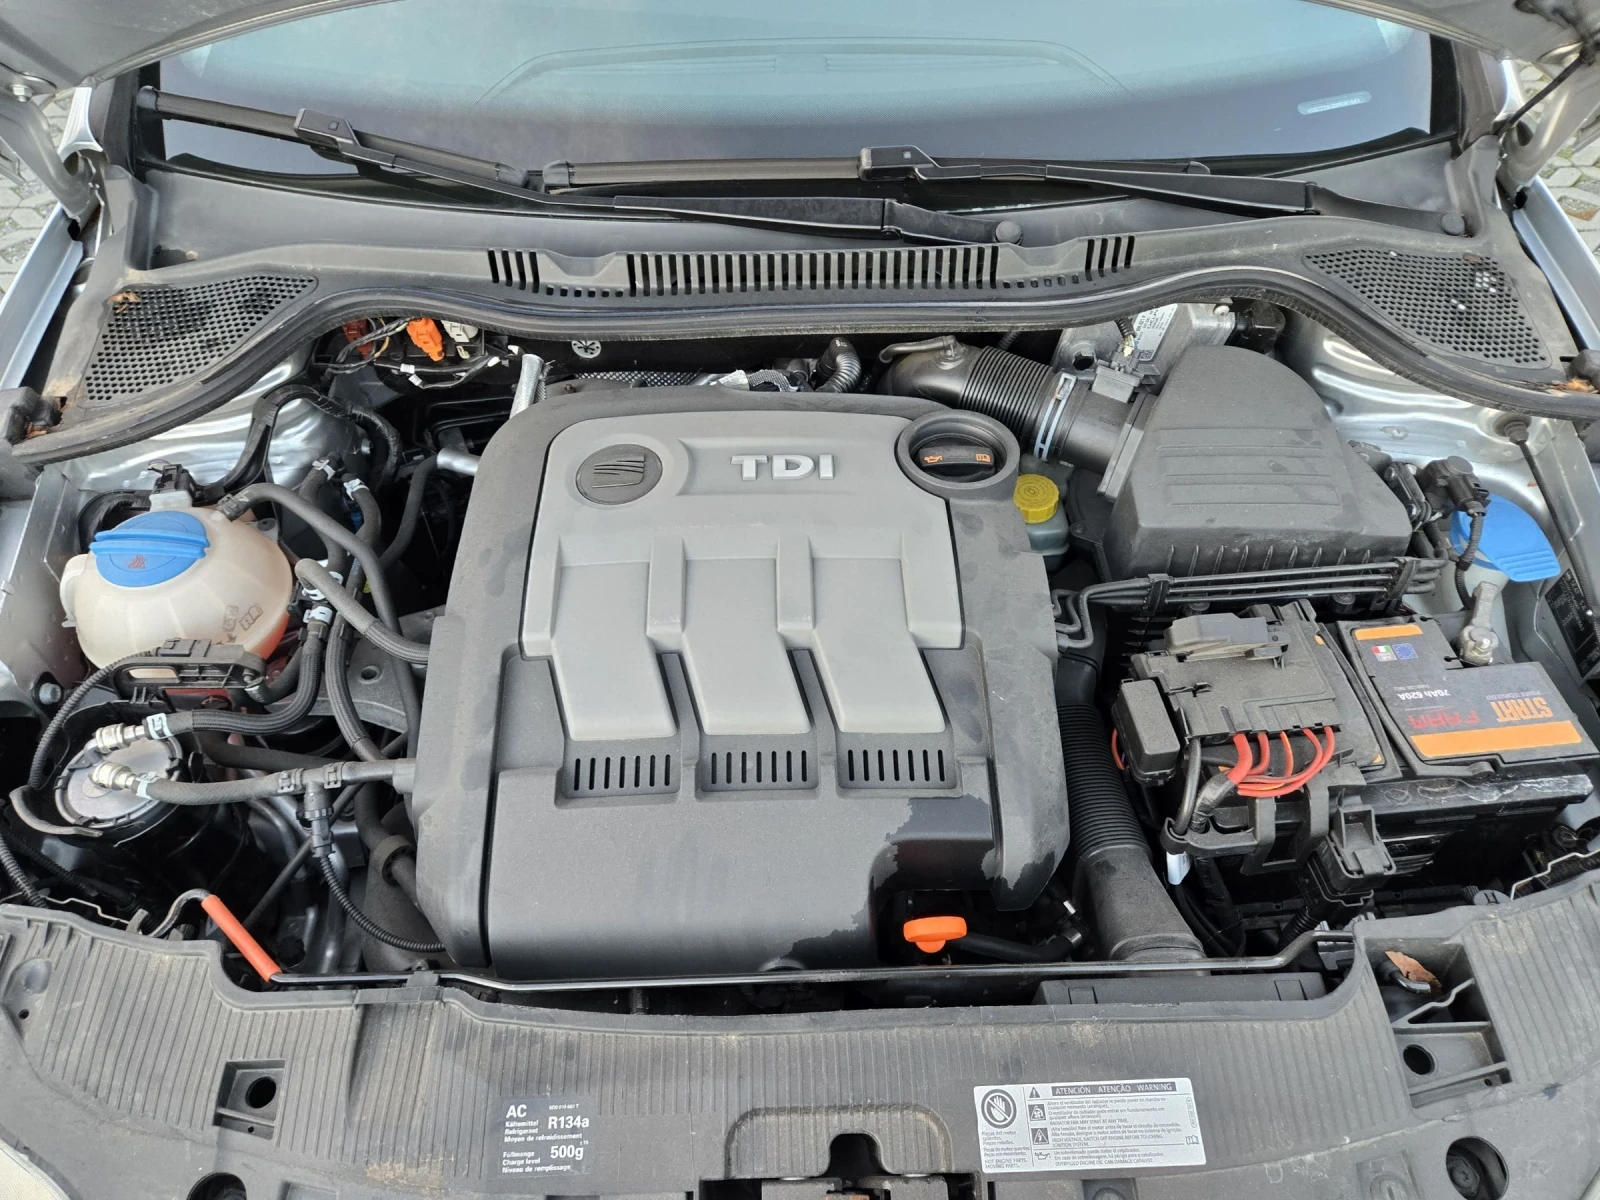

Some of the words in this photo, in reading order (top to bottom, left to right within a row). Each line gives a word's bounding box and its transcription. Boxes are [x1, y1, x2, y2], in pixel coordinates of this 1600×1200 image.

[730, 454, 836, 481] TDI
[1397, 691, 1424, 701] 620A
[1424, 689, 1451, 698] 70Ah
[1489, 696, 1554, 723] START
[1098, 1083, 1131, 1094] ATENÇÃO
[1136, 1082, 1172, 1092] WARNING
[506, 1104, 528, 1119] AC
[547, 1115, 590, 1130] R134a
[550, 1145, 584, 1160] 500g
[502, 1159, 525, 1167] Charge
